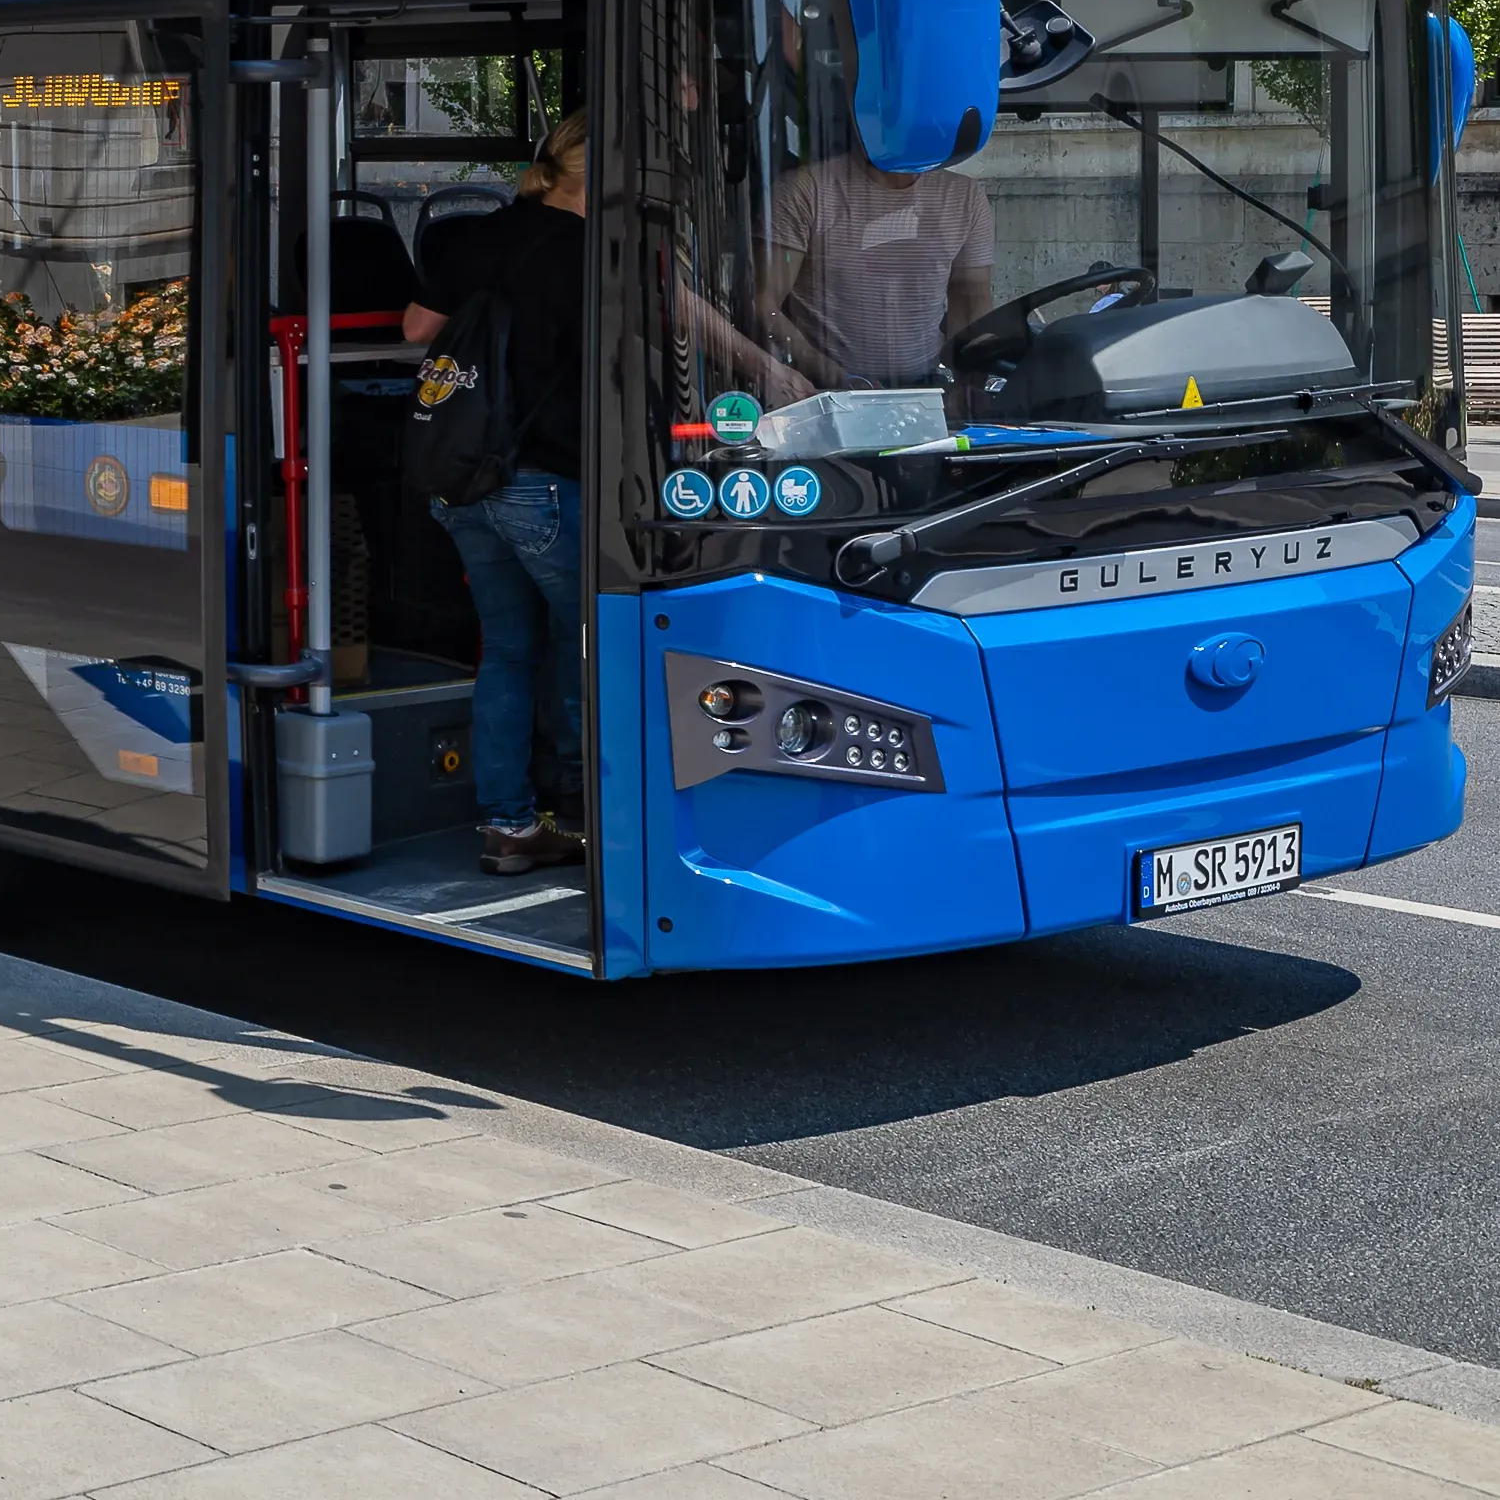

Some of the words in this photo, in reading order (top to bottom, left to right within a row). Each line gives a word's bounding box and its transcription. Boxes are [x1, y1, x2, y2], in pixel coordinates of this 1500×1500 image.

[729, 399, 743, 419] 4
[1059, 536, 1332, 594] GULERYUZ
[1156, 854, 1173, 899] M
[1193, 845, 1228, 891] SR
[1235, 831, 1296, 883] 5913
[1143, 886, 1150, 899] D
[1165, 901, 1189, 913] Autobus
[1188, 896, 1222, 909] Oberbayern
[1221, 891, 1246, 903] München
